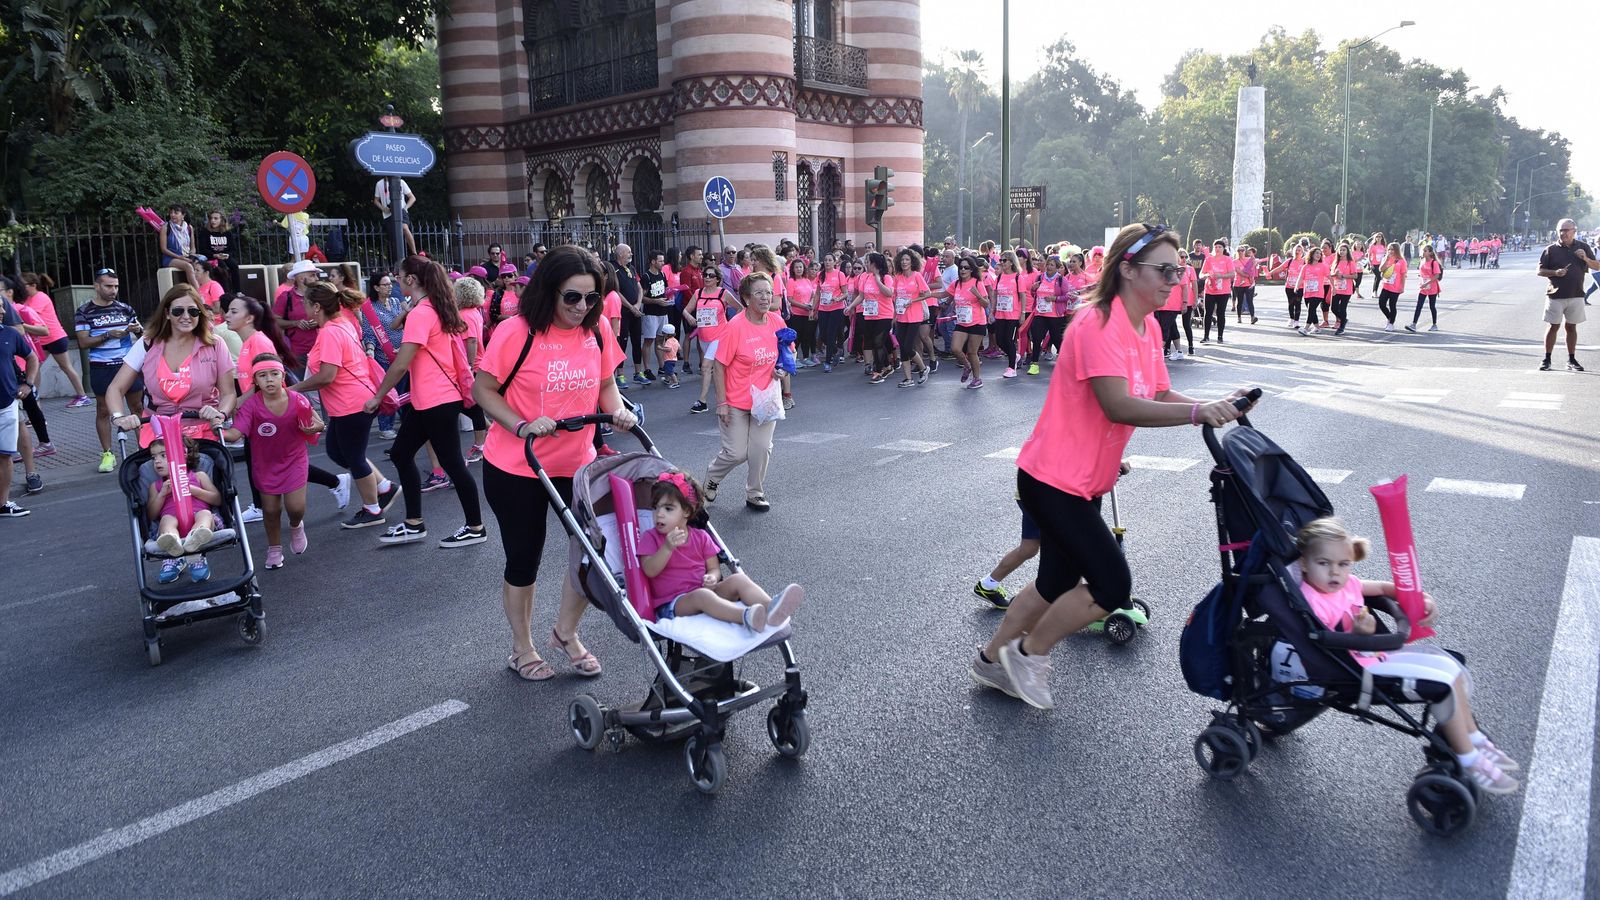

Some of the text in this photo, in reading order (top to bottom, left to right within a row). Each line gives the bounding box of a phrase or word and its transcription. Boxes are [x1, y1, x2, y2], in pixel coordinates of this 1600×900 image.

[548, 360, 569, 372] HOY
[547, 370, 586, 382] GANAN
[546, 382, 566, 392] LAS
[178, 464, 191, 497] Ladival
[1390, 552, 1415, 592] Ladival
